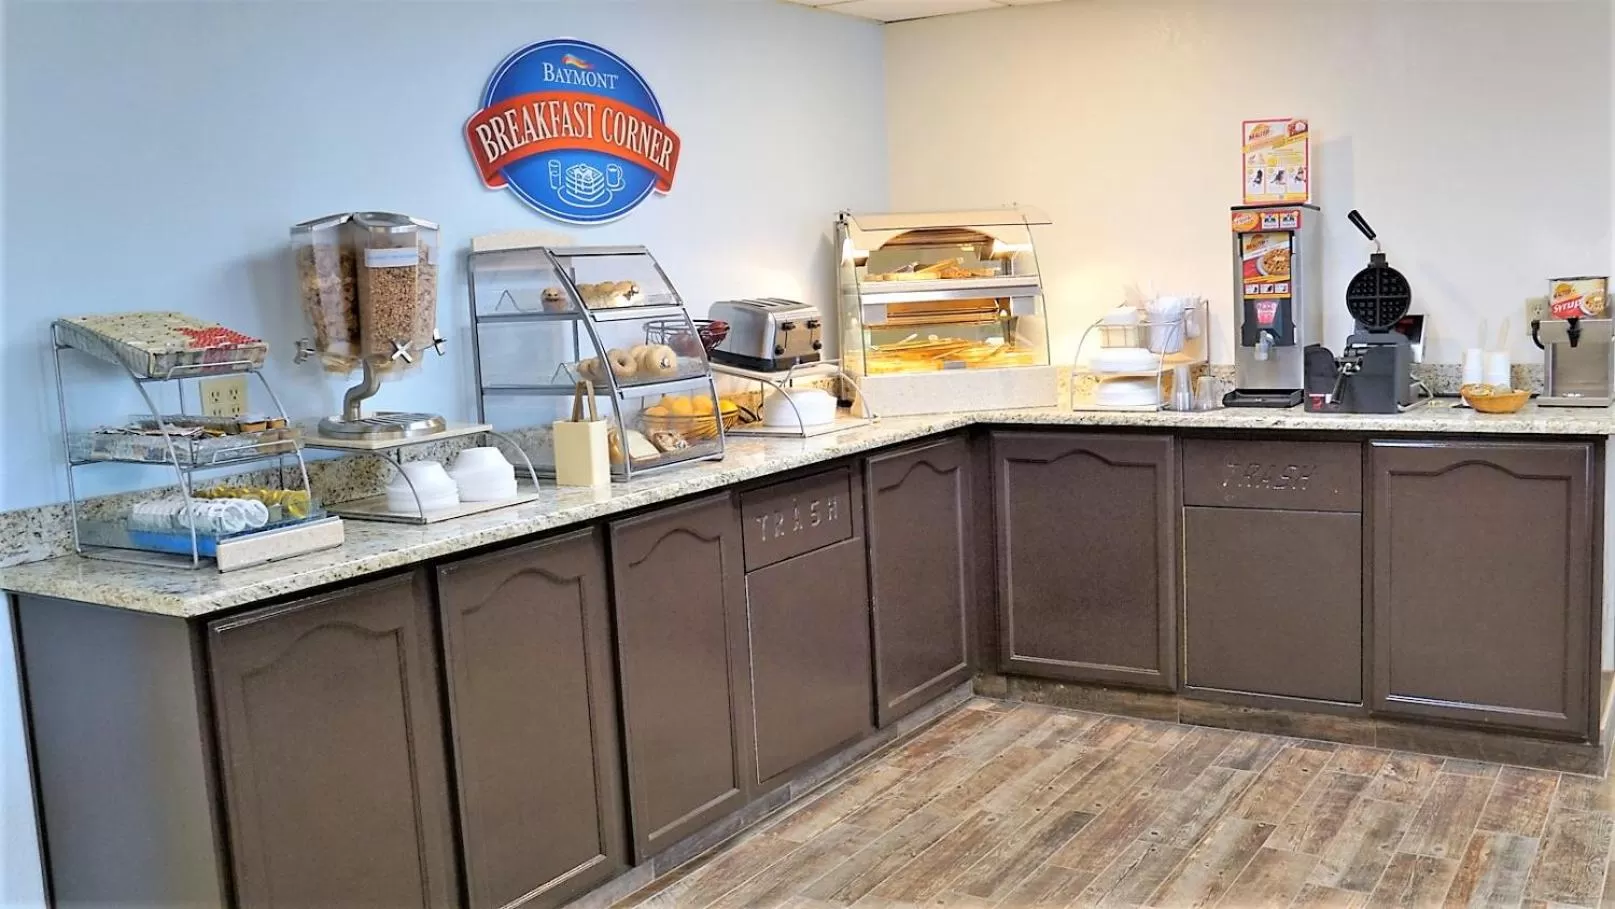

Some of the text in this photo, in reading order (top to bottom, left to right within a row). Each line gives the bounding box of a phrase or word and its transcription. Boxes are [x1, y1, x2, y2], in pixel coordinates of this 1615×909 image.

[543, 62, 618, 89] BAYMONT
[477, 100, 674, 171] BREAKFAST CORNER
[1222, 464, 1318, 490] TRASH
[756, 496, 838, 542] TRASH
